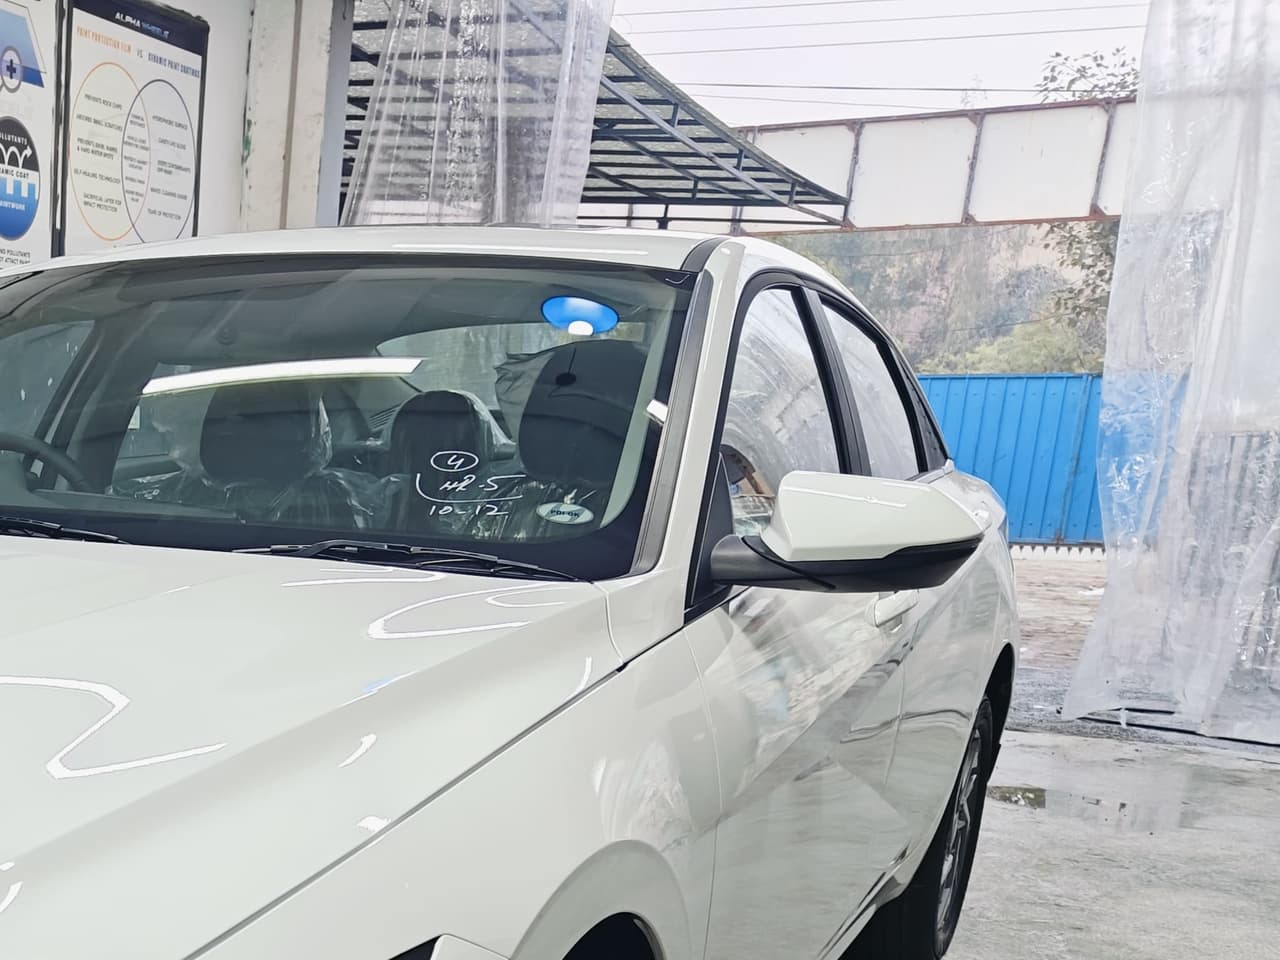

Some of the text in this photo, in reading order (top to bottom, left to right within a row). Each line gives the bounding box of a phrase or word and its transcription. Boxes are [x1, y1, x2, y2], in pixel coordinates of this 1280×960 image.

[114, 12, 140, 28] ALPHA
[15, 170, 29, 179] COAT
[447, 454, 465, 470] 4
